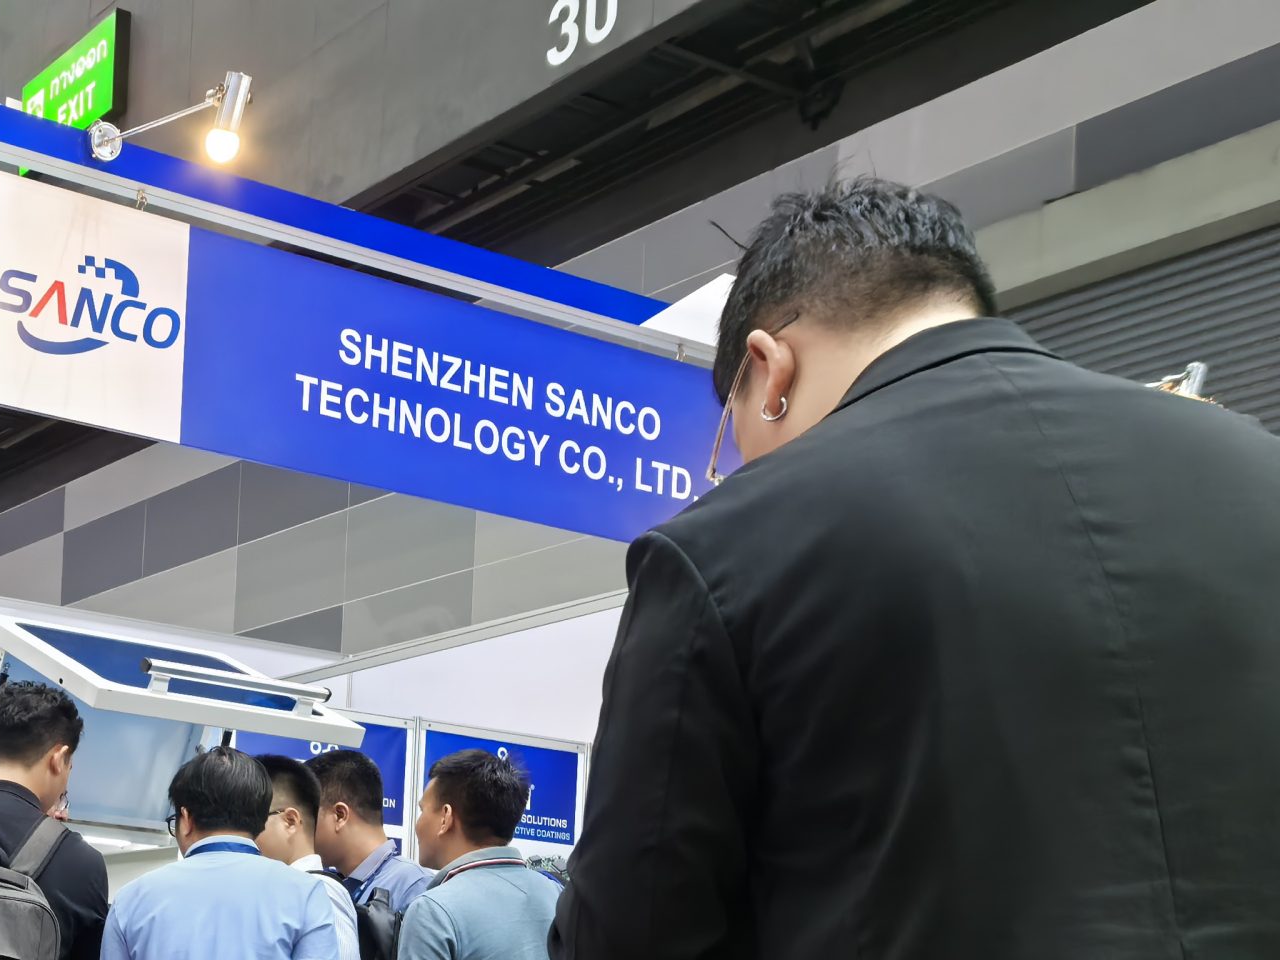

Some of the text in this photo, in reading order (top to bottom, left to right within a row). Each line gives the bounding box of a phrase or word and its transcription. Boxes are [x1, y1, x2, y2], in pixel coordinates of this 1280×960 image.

[546, 0, 618, 65] 30
[57, 81, 96, 126] EXIT
[338, 328, 661, 441] SHENZHEN SANCO
[295, 373, 700, 502] TECHNOLOGY CO., LTD.
[521, 814, 568, 829] SOLUTIONS
